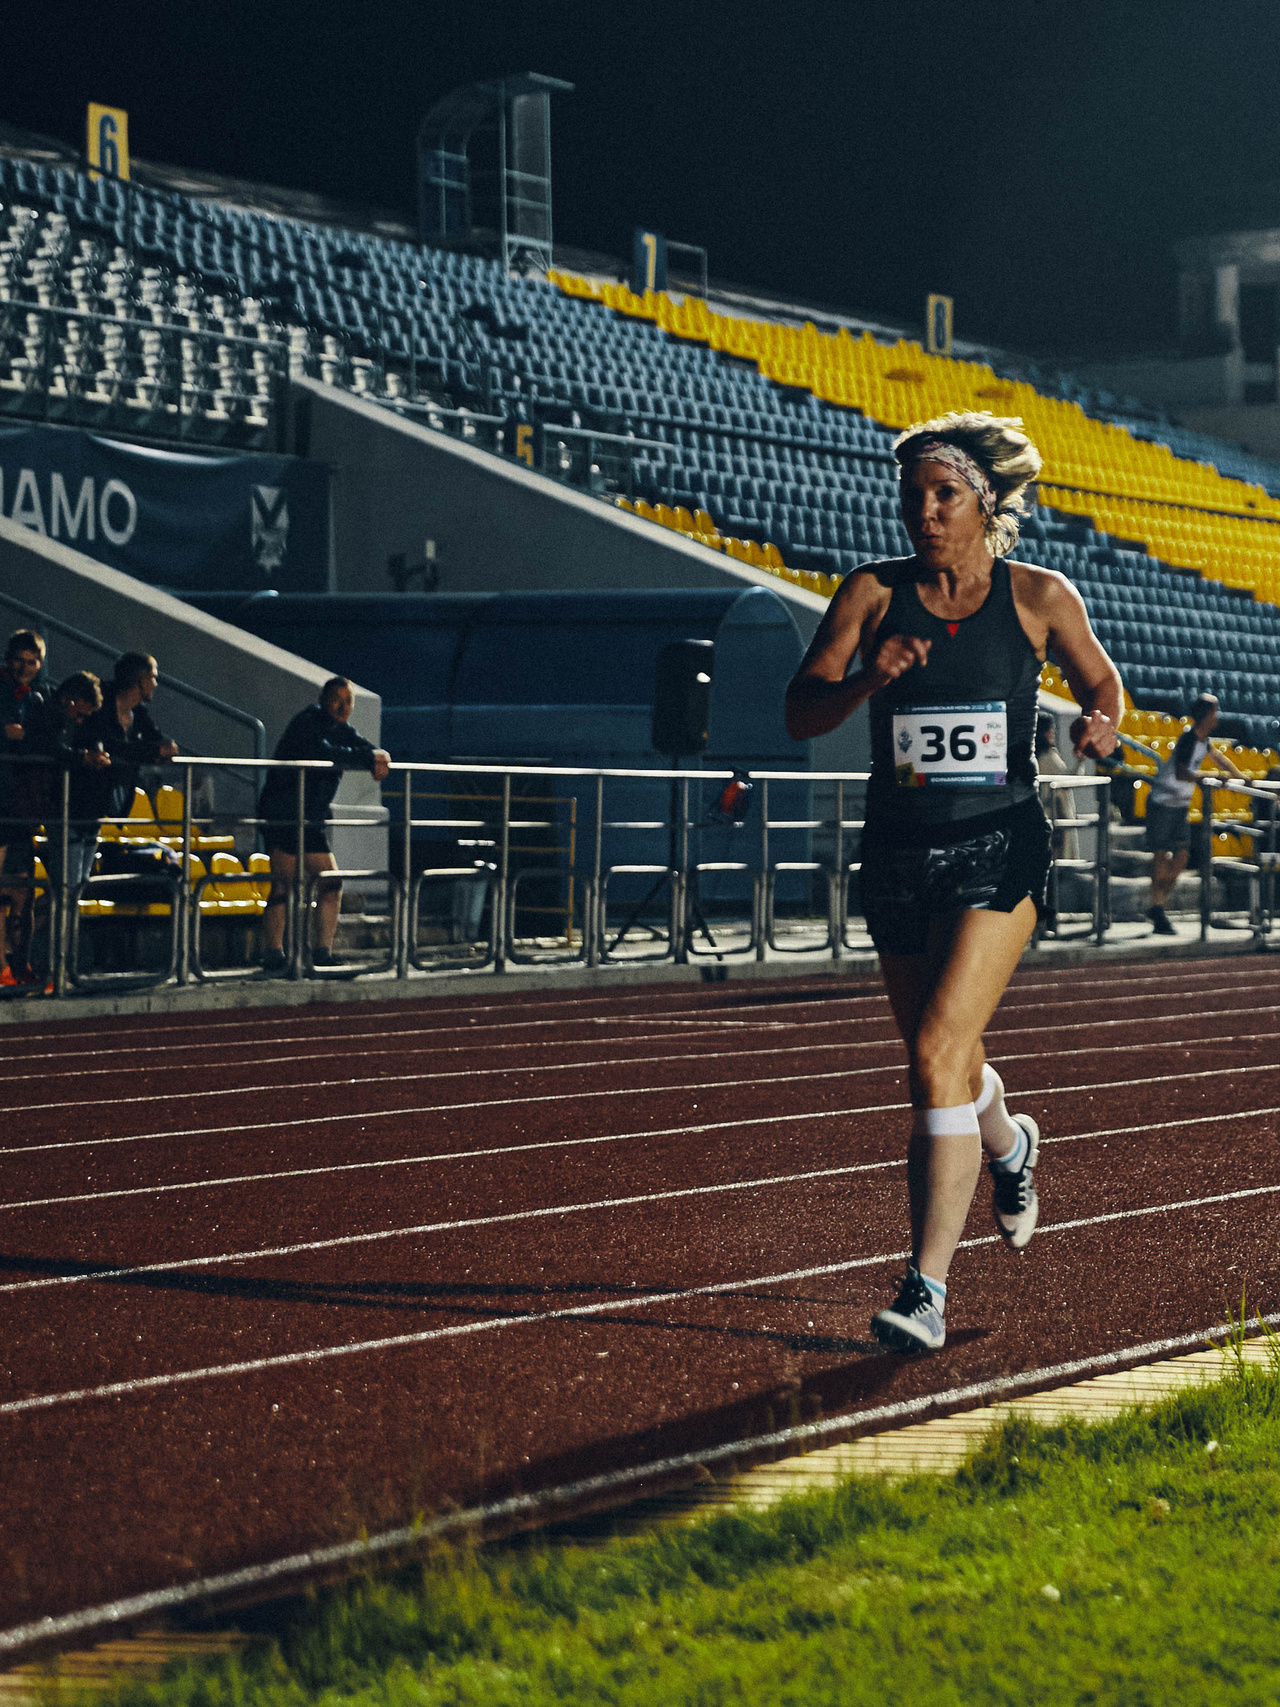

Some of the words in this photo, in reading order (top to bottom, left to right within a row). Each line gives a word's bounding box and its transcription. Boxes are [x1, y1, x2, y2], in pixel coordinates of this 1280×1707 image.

[99, 114, 119, 174] 6
[0, 467, 137, 545] AMO
[920, 725, 977, 762] 36
